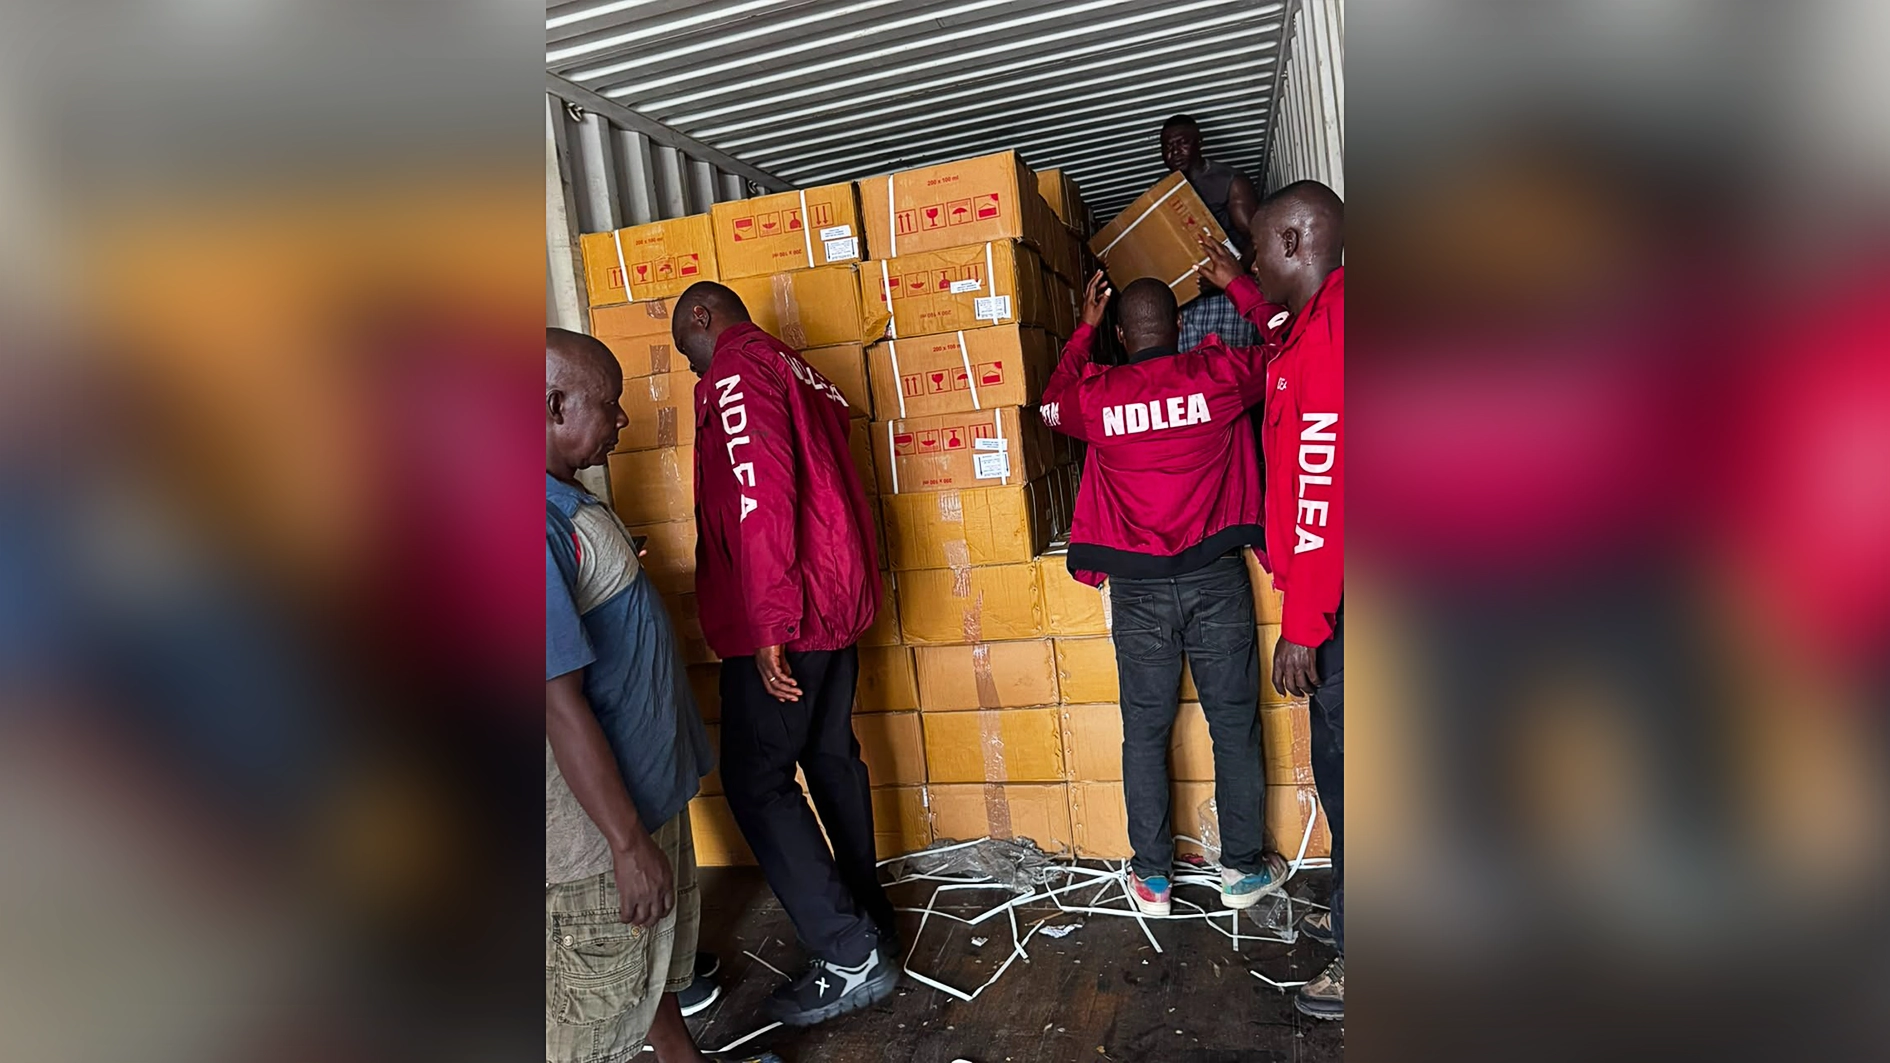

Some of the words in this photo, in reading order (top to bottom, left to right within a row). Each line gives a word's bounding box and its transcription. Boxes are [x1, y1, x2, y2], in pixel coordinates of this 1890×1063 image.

[715, 373, 758, 524] NDLEA
[1102, 392, 1212, 437] NDLEA
[1293, 412, 1339, 555] NDLEA
